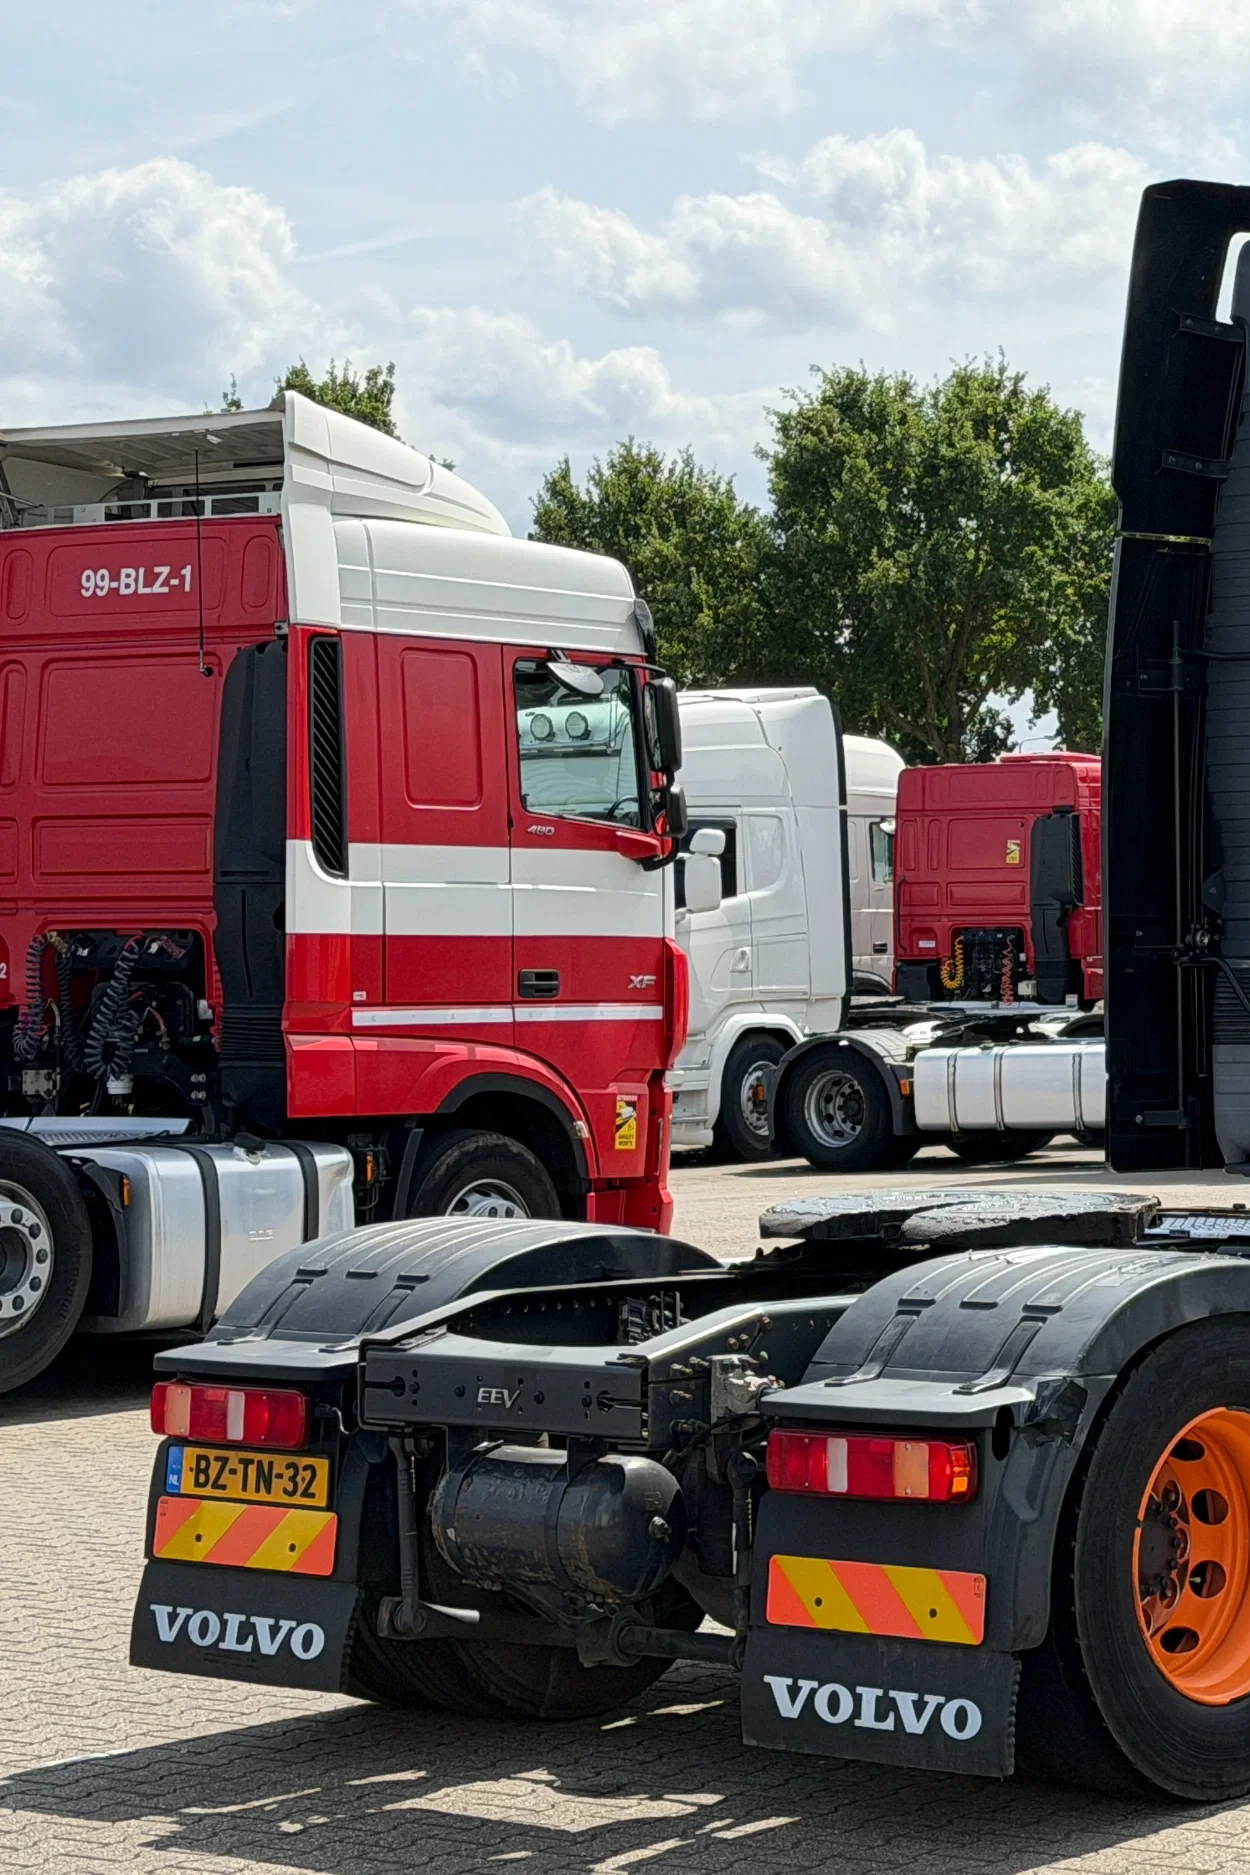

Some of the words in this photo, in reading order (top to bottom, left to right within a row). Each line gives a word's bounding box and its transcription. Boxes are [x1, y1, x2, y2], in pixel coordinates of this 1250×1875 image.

[81, 565, 192, 597] 99-BLZ-1
[628, 975, 657, 989] XF
[477, 1387, 521, 1409] EEV
[168, 1473, 180, 1486] NL
[193, 1454, 317, 1499] BZ-TN-32
[150, 1604, 325, 1660] VOLVO
[763, 1675, 983, 1741] VOLVO
